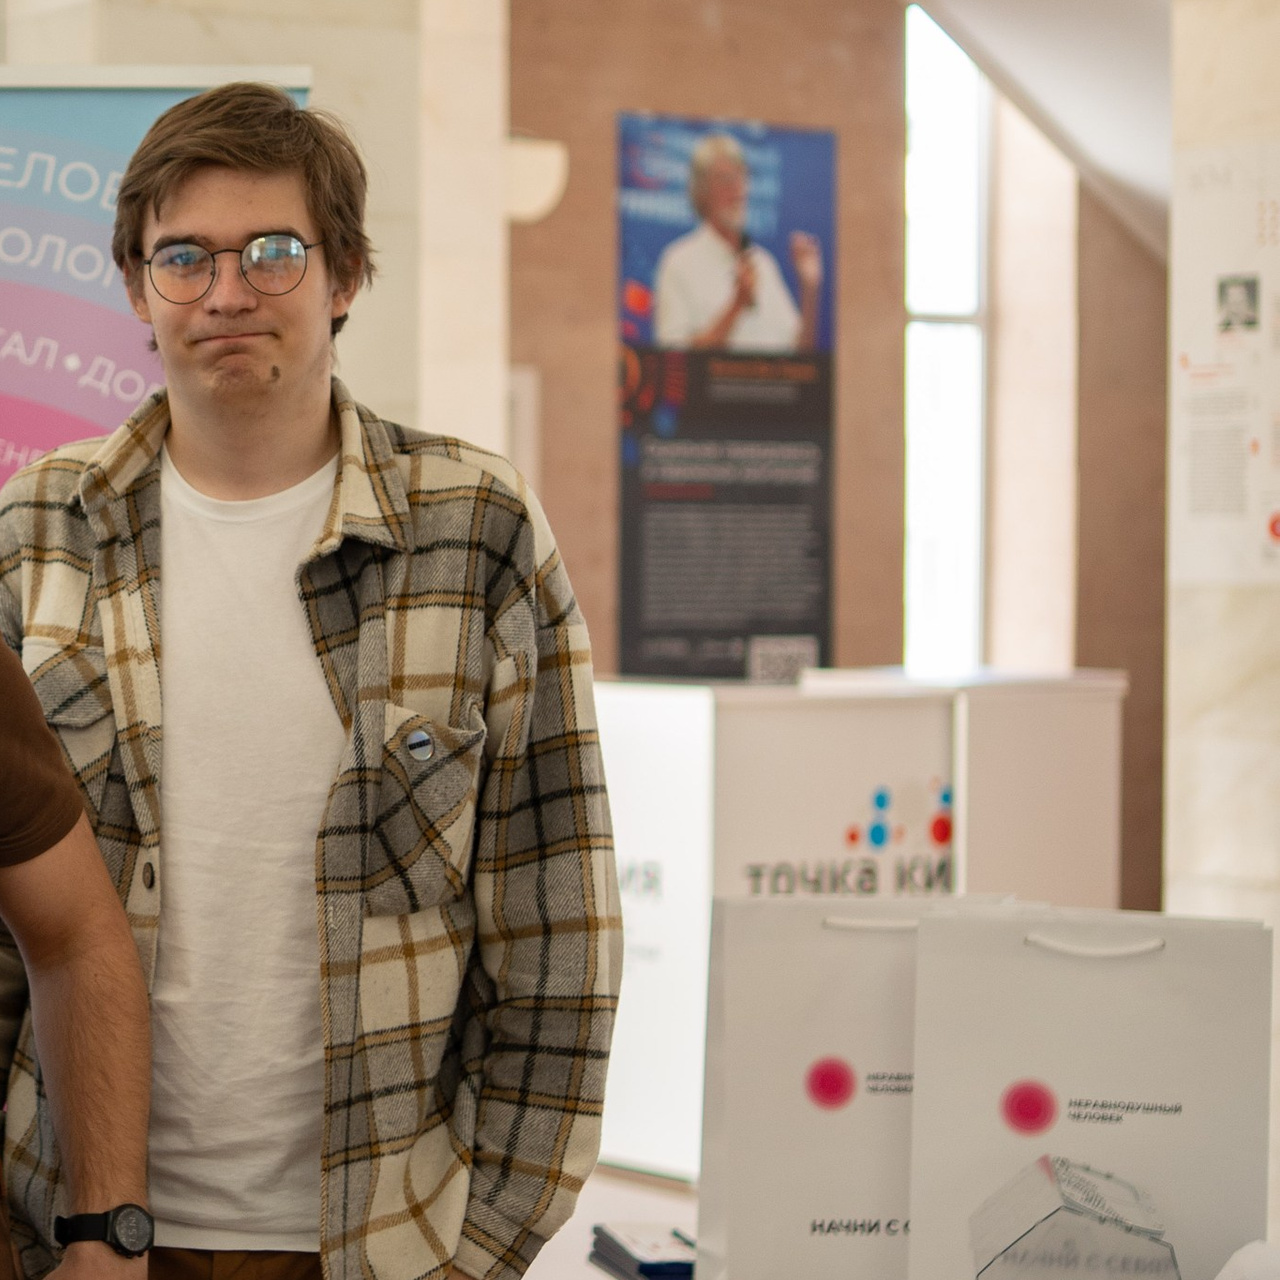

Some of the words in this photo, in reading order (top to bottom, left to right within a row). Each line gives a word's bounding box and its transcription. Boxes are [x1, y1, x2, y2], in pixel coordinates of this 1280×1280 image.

[1068, 1098, 1183, 1115] НЕРАВНОДУШНЫЙ
[1067, 1110, 1124, 1123] ЧЕЛОВЕК
[810, 1218, 881, 1235] НАЧНИ
